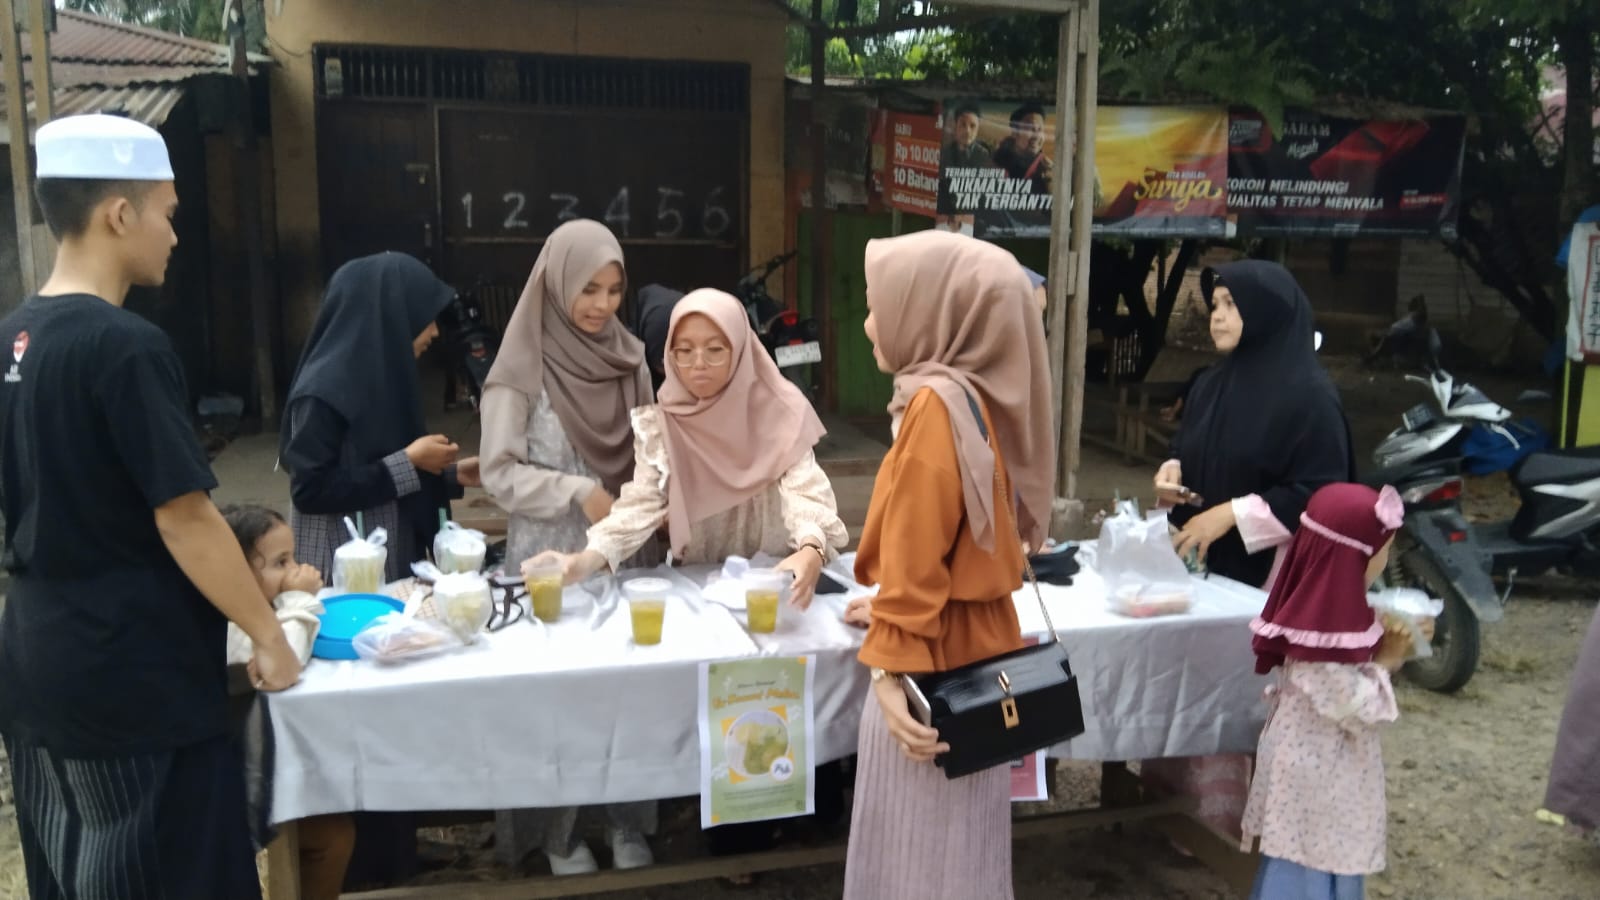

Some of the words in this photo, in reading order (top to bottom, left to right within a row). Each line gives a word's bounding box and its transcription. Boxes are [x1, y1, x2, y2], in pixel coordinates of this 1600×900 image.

[895, 142, 907, 162] Rp
[894, 168, 906, 185] 10
[949, 177, 1032, 194] NIKMATNYA
[1134, 171, 1223, 212] Surya
[1269, 179, 1350, 194] MELINDUNGI
[956, 193, 980, 210] TAK
[1227, 193, 1277, 208] UALITAS
[1282, 195, 1321, 208] TETAP
[1325, 196, 1384, 210] MENYALA
[461, 192, 473, 228] 1
[503, 191, 528, 228] 2
[605, 186, 630, 236] 4
[655, 187, 684, 237] 5
[703, 186, 730, 236] 6
